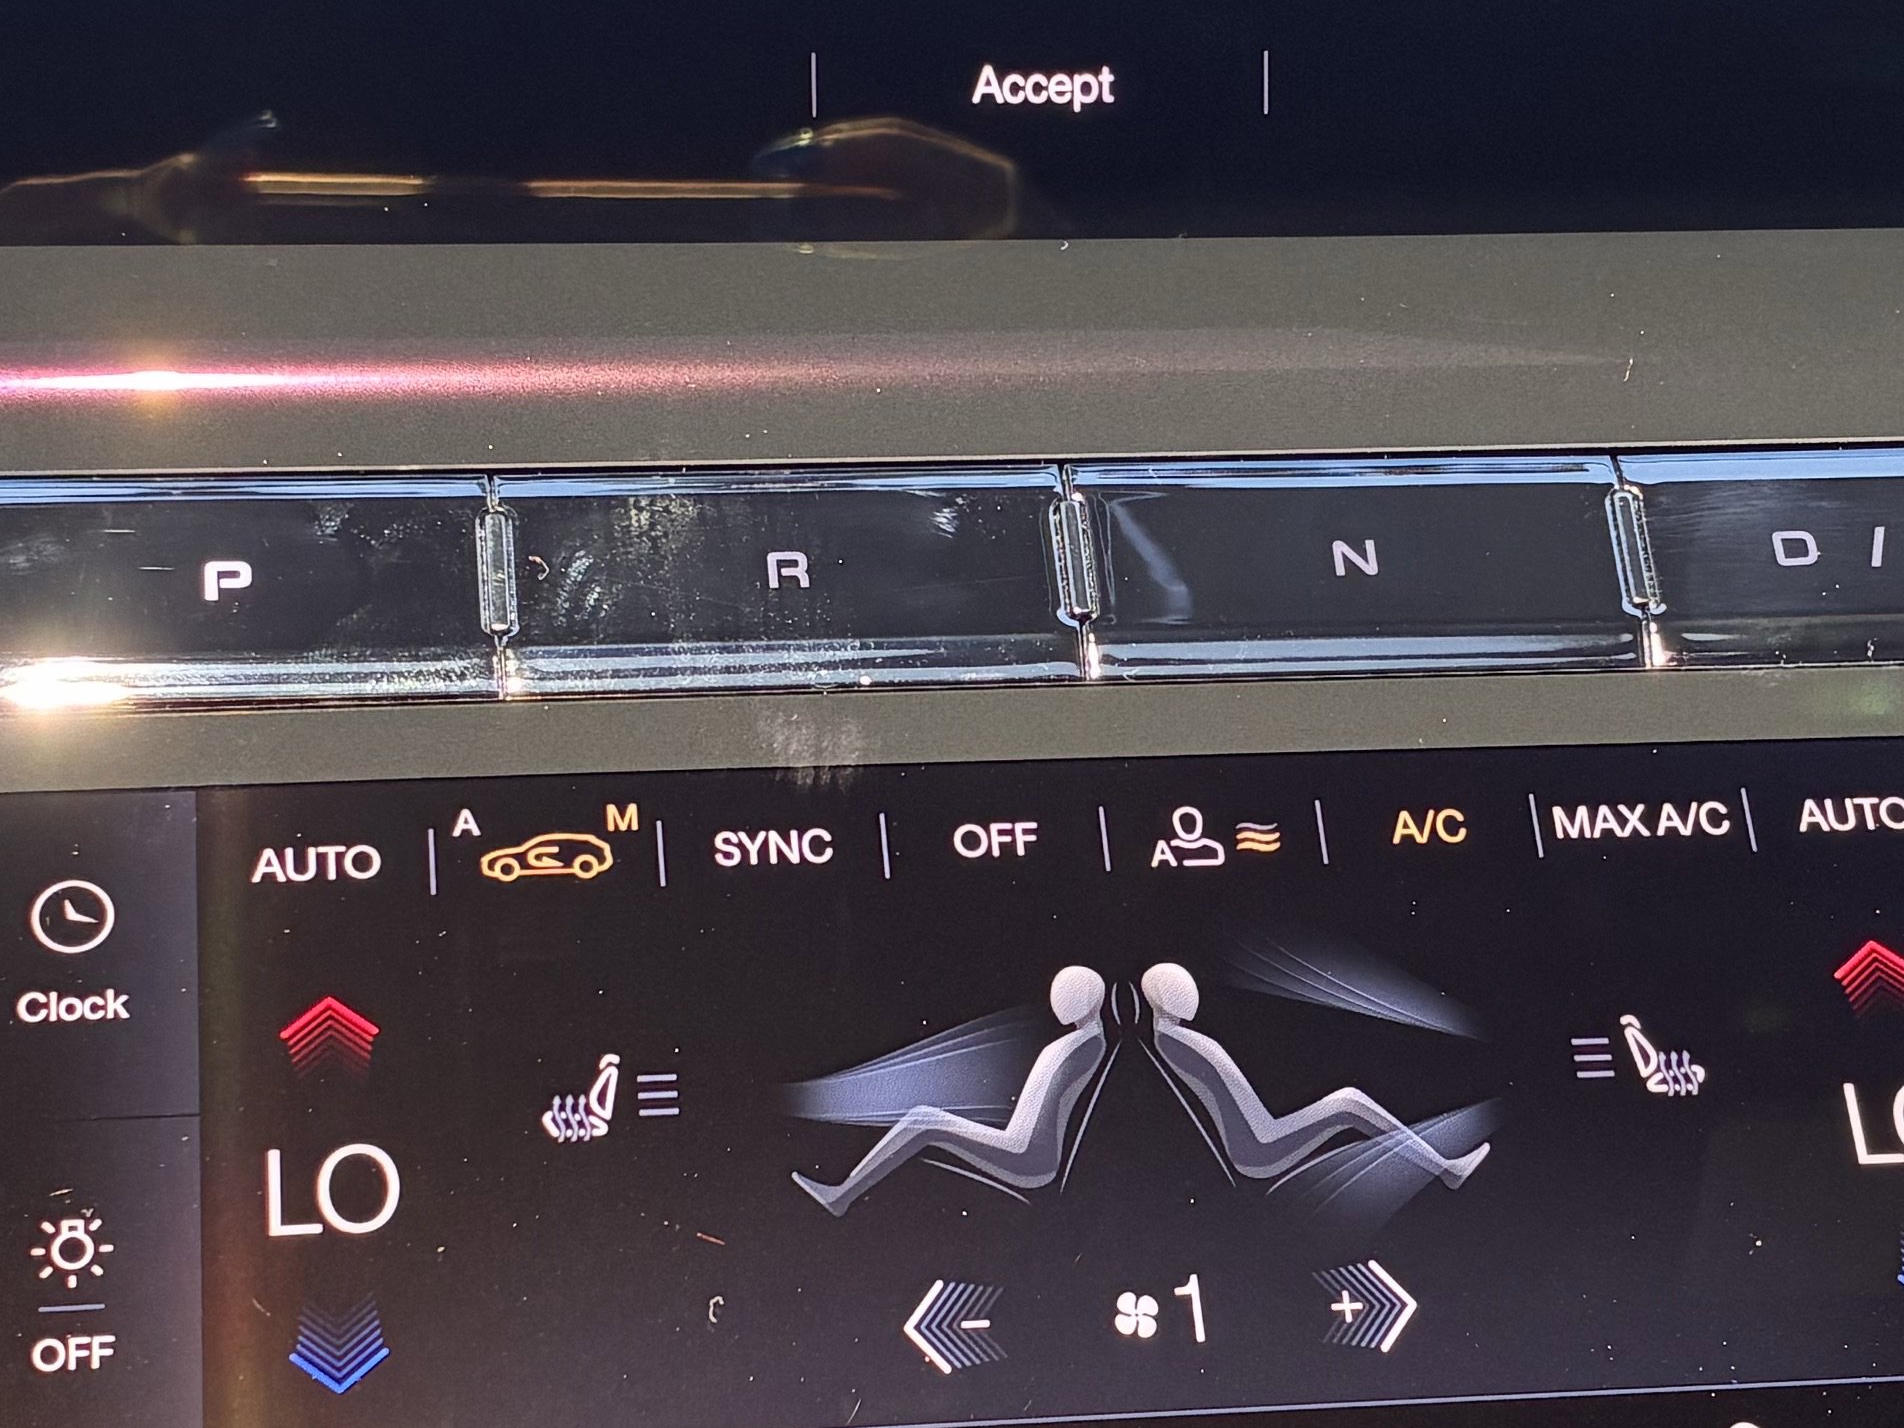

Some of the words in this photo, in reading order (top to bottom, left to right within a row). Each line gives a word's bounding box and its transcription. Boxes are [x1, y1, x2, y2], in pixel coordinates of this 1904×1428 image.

[971, 64, 1115, 113] Accept
[1331, 539, 1379, 577] N
[1771, 530, 1821, 567] D
[203, 560, 253, 602] P
[766, 551, 810, 589] R
[452, 808, 482, 838] A
[606, 802, 639, 832] M
[1392, 808, 1467, 845] A/C
[1551, 803, 1652, 840] MAX
[1656, 800, 1731, 837] A/C
[714, 827, 834, 867] SYNC
[953, 821, 1038, 859] OFF
[250, 844, 382, 884] AUTO
[16, 988, 131, 1023] Clock
[266, 1143, 401, 1237] LO
[1173, 1273, 1206, 1343] 1
[31, 1334, 116, 1373] OFF
